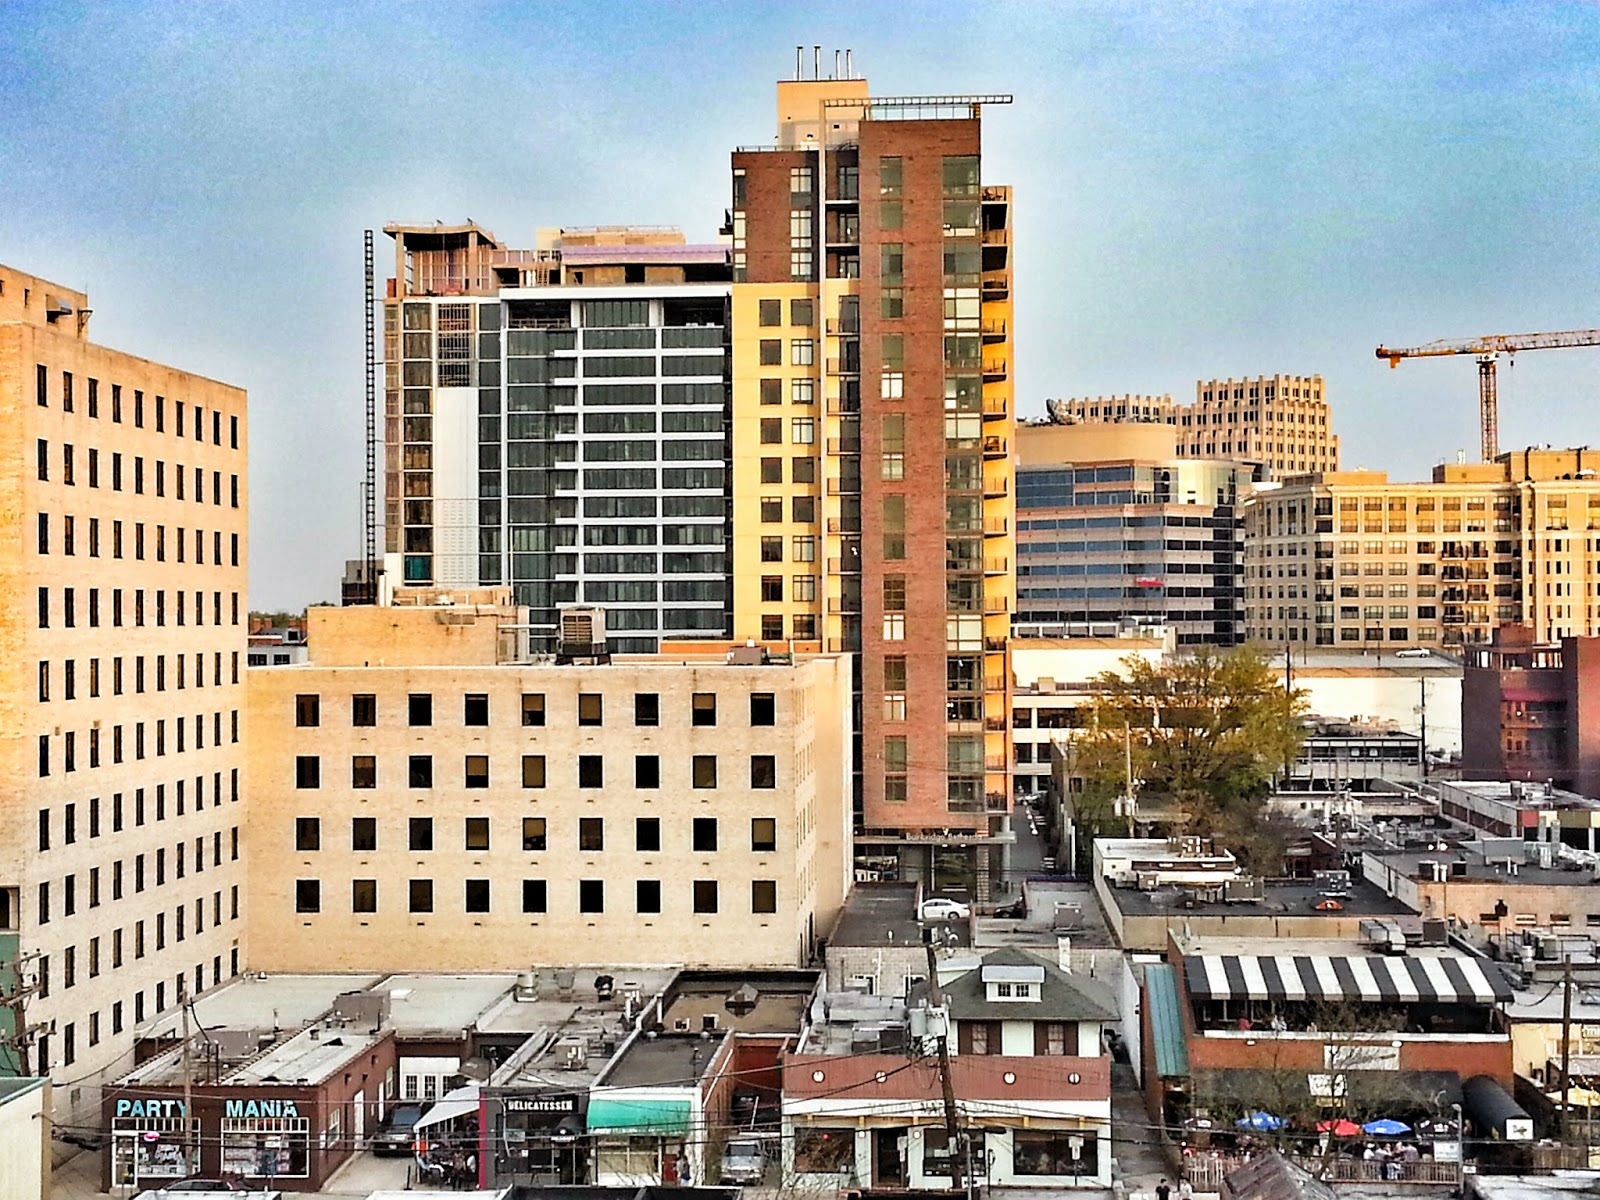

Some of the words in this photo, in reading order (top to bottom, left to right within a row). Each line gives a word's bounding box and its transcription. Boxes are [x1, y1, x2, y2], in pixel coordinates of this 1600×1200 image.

[116, 1099, 187, 1117] PARTY
[225, 1099, 298, 1118] MANIA
[508, 1100, 573, 1111] DELICATESSEN
